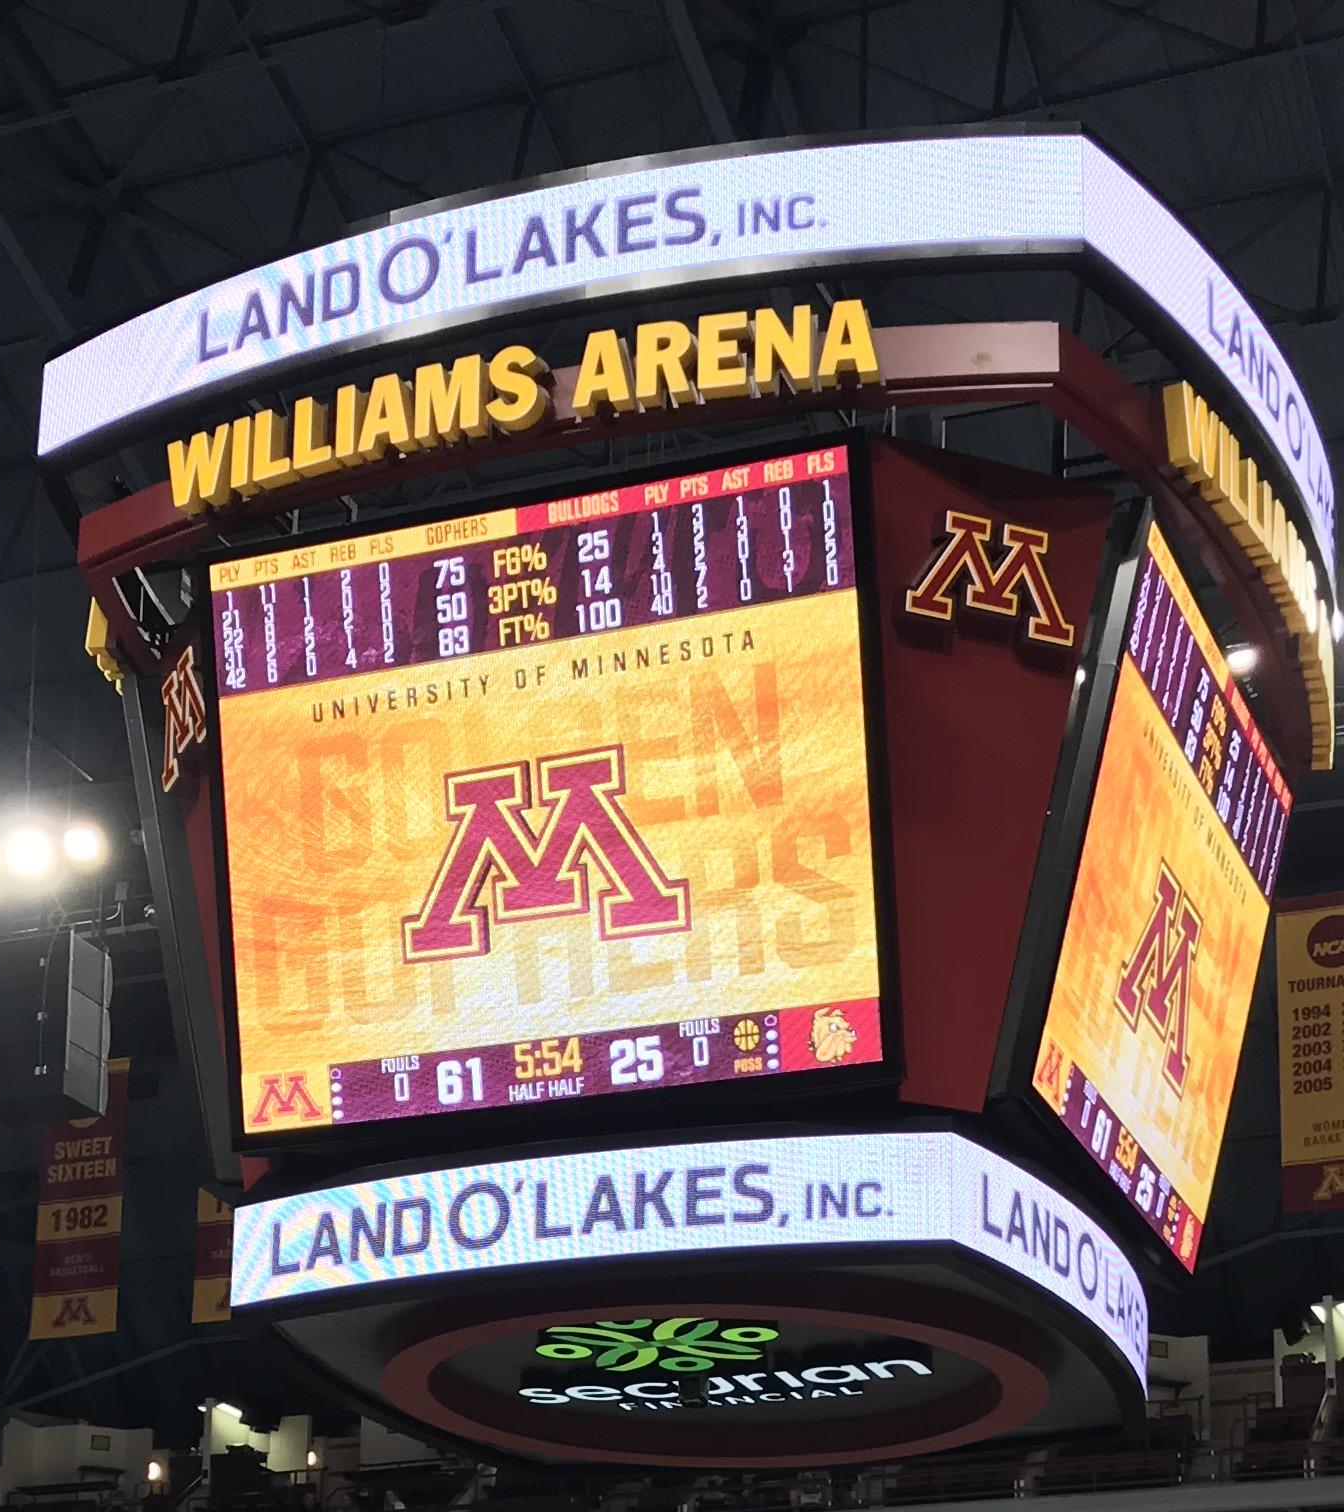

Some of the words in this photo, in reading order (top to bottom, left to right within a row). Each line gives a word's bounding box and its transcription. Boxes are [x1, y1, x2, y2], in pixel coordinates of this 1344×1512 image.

[197, 259, 362, 365] LAND
[735, 190, 829, 236] INC.
[1205, 276, 1281, 422] LAND
[167, 344, 553, 513] WILLIAMS
[573, 299, 880, 417] ARENA
[645, 483, 669, 505] PLY
[680, 475, 708, 498] PTS
[722, 468, 750, 491] AST
[764, 460, 794, 483] REB
[808, 452, 835, 475] FLS
[548, 491, 620, 524] BULLDOGS
[425, 517, 488, 545] GOPHERS
[220, 566, 240, 583] PLY
[255, 559, 278, 577] PTS
[292, 551, 316, 569] AST
[331, 544, 356, 562] REB
[370, 535, 394, 556] FLS
[434, 557, 465, 589] 75
[493, 543, 547, 578] FG%
[577, 530, 609, 563] 25
[906, 510, 1075, 647] M
[436, 592, 467, 624] 50
[488, 577, 557, 614] 3PT%
[581, 566, 612, 597] 14
[651, 572, 672, 595] 10
[651, 593, 673, 615] 40
[438, 625, 469, 657] 83
[499, 613, 550, 647] FT%
[576, 598, 622, 632] 100
[226, 668, 246, 688] 42
[312, 676, 491, 723] UNIVERSITY
[514, 666, 547, 692] OF
[571, 629, 757, 680] MINNESOTA
[401, 744, 692, 964] M
[678, 1018, 720, 1038] FOULS
[1292, 1004, 1331, 1022] 1994
[1292, 1022, 1331, 1040] 2002
[381, 1055, 420, 1074] FOULS
[514, 1037, 584, 1080] 5:54
[609, 1035, 664, 1085] 25
[692, 1037, 709, 1067] 0
[1292, 1040, 1332, 1058] 2003
[1293, 1058, 1332, 1077] 2004
[249, 1071, 327, 1127] M
[393, 1073, 410, 1102] 0
[436, 1057, 484, 1106] 61
[509, 1081, 546, 1103] HALF
[548, 1077, 585, 1098] HALF
[1293, 1077, 1333, 1095] 2005
[54, 1136, 112, 1160] SWEET
[47, 1157, 117, 1184] SIXTEEN
[51, 1204, 108, 1232] 1982
[269, 1197, 433, 1277] LAND
[803, 1180, 894, 1221] INC.
[981, 1172, 1071, 1278] LAND
[518, 1358, 933, 1406] securian
